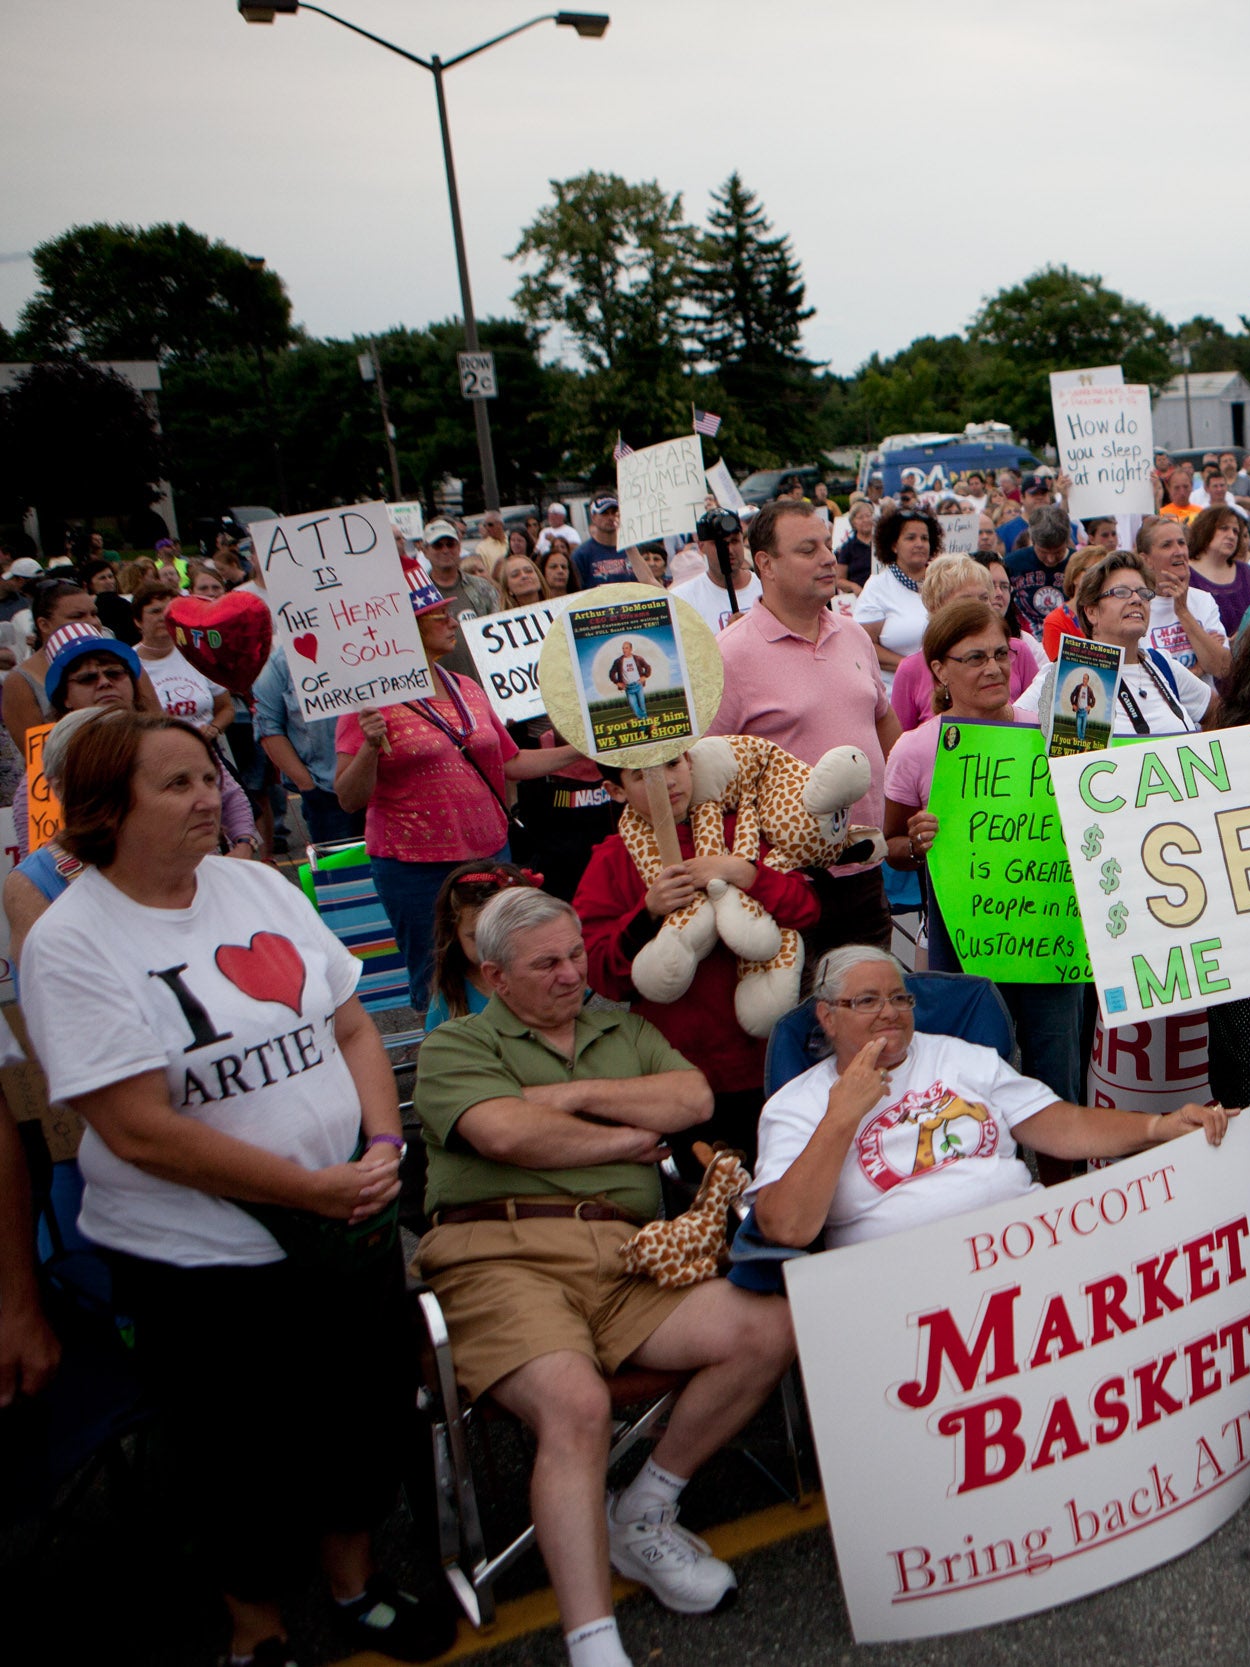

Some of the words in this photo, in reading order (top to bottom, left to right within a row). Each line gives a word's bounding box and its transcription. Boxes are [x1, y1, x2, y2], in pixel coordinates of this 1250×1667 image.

[1066, 413, 1109, 440] How
[1115, 411, 1138, 435] do
[1067, 447, 1094, 471] you
[1101, 440, 1141, 461] sleep
[1074, 464, 1089, 485] at
[1098, 459, 1151, 494] night?
[265, 512, 378, 571] ATD
[312, 566, 343, 591] IS
[277, 602, 320, 633] THE
[328, 592, 401, 631] HEART
[574, 610, 606, 620] Arthur
[622, 600, 667, 613] DeMoulas
[339, 638, 415, 667] SOUL
[1090, 643, 1120, 656] DeMoulas
[301, 671, 331, 693] OF
[1120, 690, 1138, 719] Canon
[594, 723, 604, 735] If
[607, 721, 628, 735] you
[629, 716, 661, 727] bring
[663, 711, 689, 723] him,
[597, 736, 617, 748] WE
[618, 730, 649, 745] WILL
[650, 722, 691, 739] SHOP!!
[958, 752, 1016, 799] THE
[1079, 740, 1232, 813] CAN
[968, 811, 1054, 844] PEOPLE
[969, 852, 991, 880] is
[1005, 858, 1075, 884] GREATE
[972, 894, 1037, 921] People
[1043, 901, 1060, 917] in
[955, 928, 1074, 960] CUSTOMERS
[1131, 937, 1231, 1009] ME
[148, 963, 233, 1054] I
[181, 1023, 324, 1107] ARTIE
[963, 1164, 1178, 1273] BOYCOTT
[887, 1522, 1054, 1597] Bring
[1065, 1461, 1182, 1548] back
